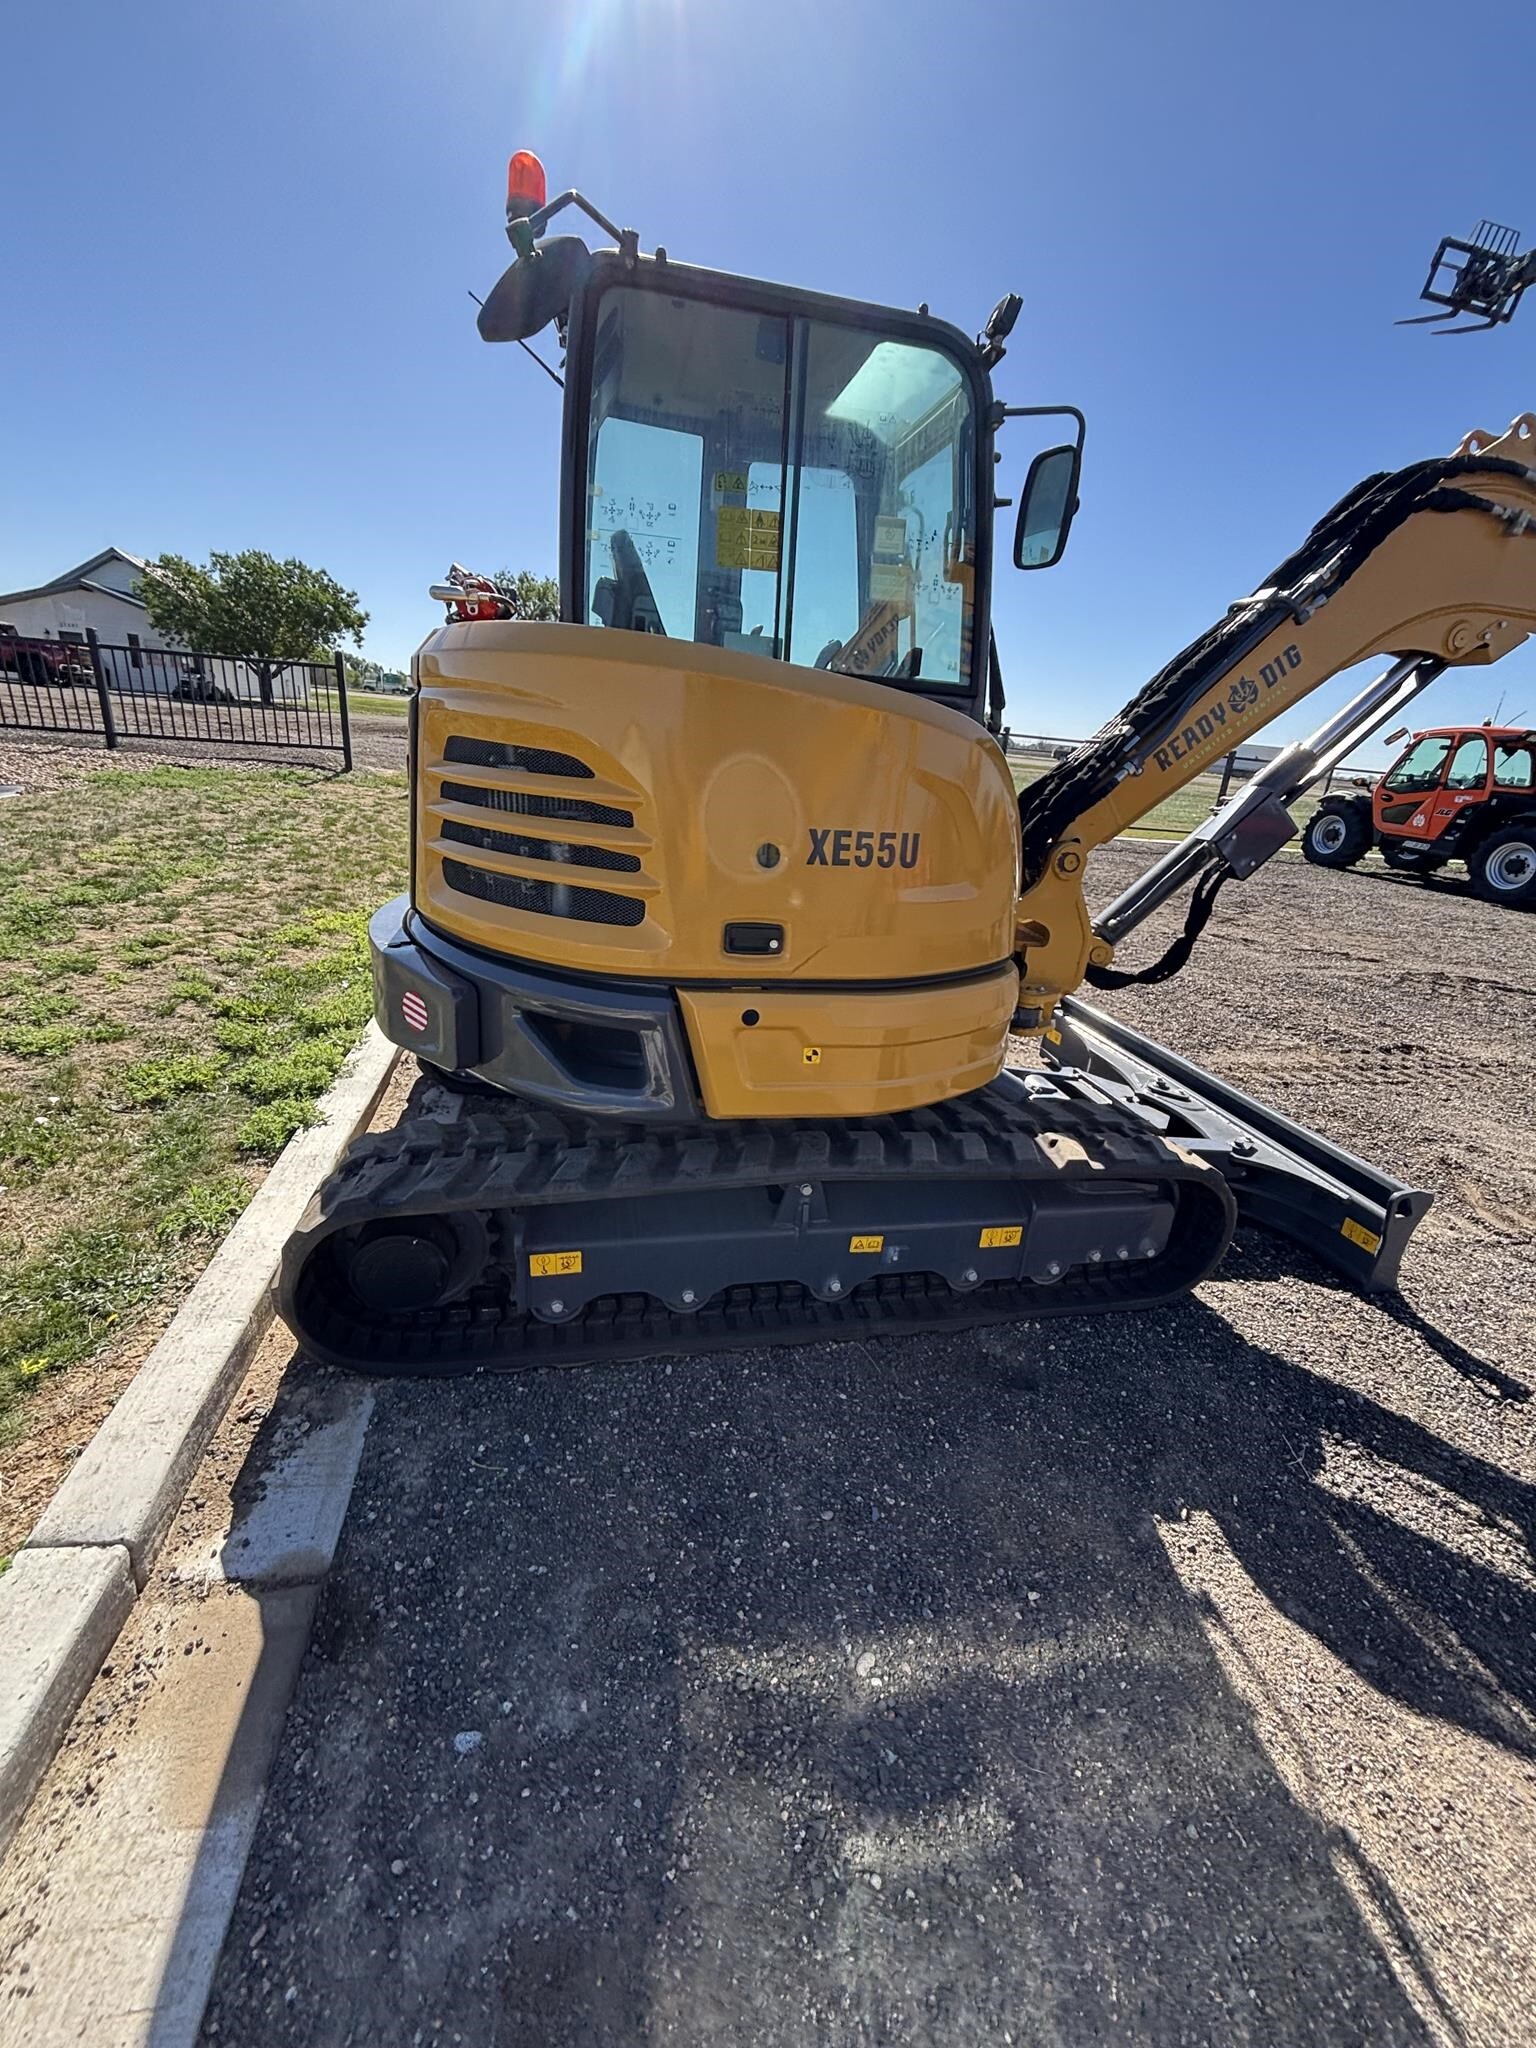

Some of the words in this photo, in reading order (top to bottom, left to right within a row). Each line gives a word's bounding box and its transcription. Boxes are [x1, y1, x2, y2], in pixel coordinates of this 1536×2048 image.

[1153, 702, 1226, 771] READY
[1259, 644, 1302, 688] DIG
[1183, 728, 1233, 769] UNLIMITED
[1236, 685, 1287, 727] POTENTIAL
[806, 828, 920, 869] XE55U
